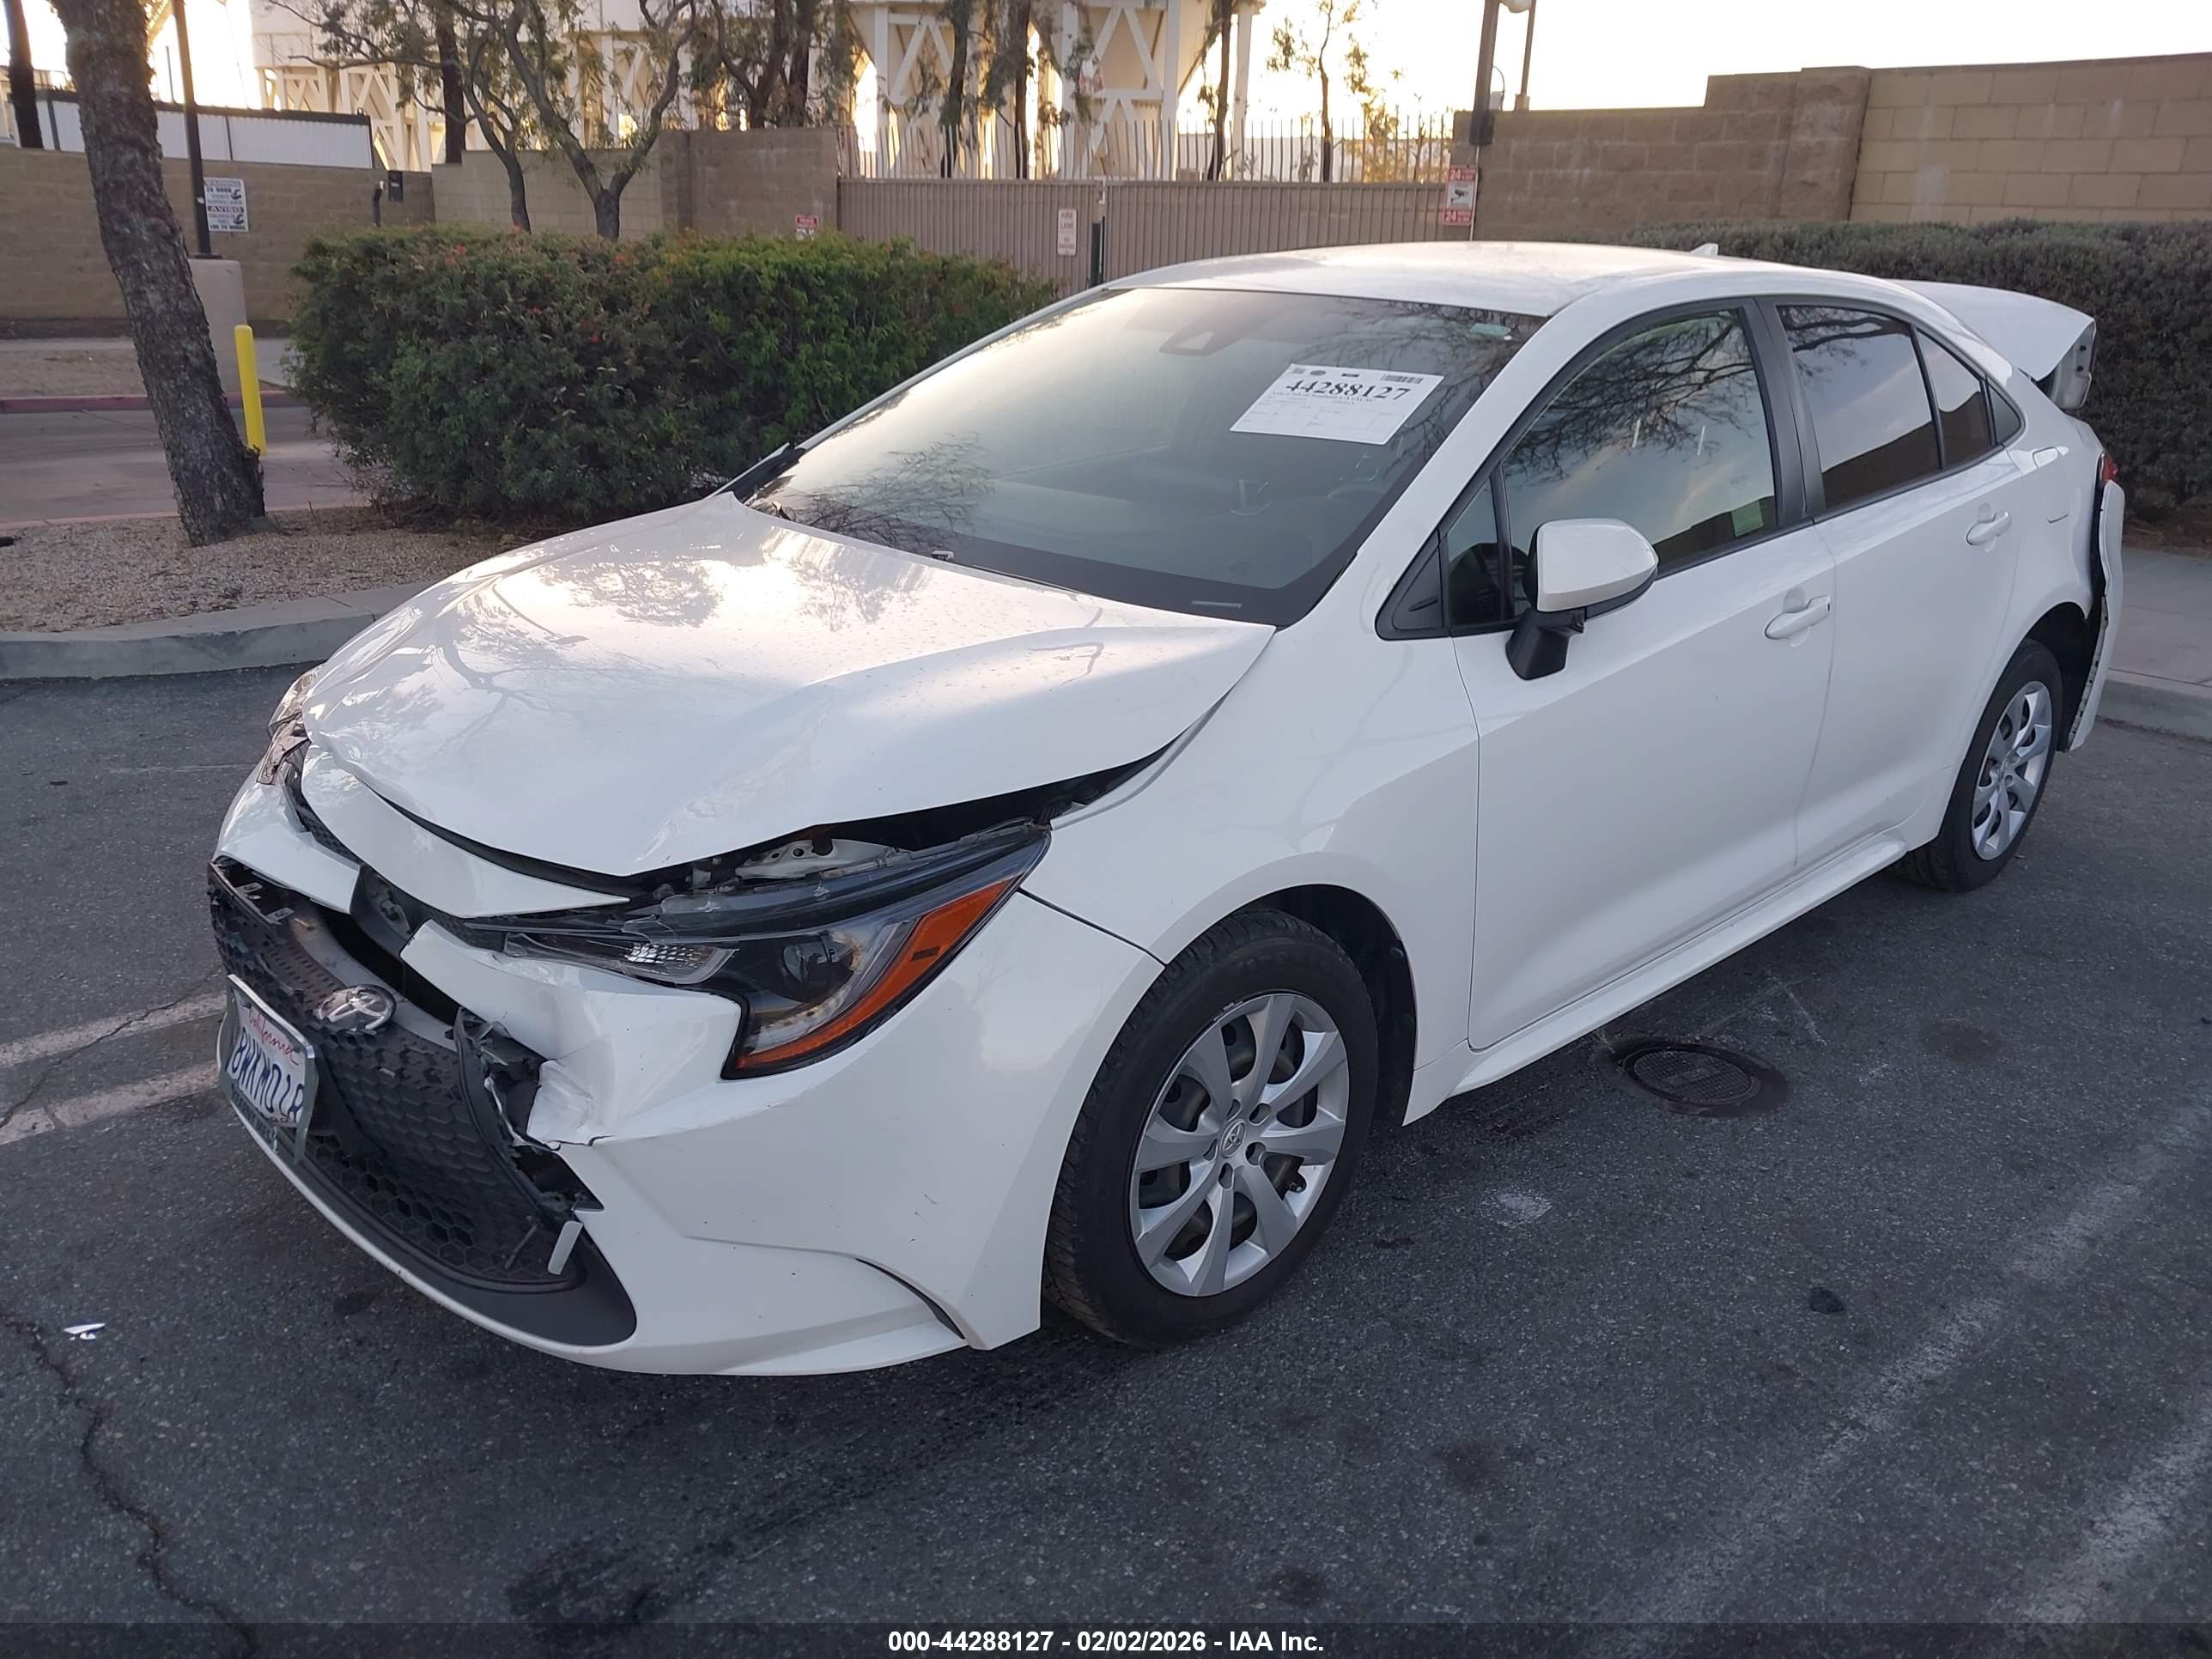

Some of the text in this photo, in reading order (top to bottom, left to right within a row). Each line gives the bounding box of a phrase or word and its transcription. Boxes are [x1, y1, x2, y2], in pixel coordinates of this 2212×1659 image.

[1450, 169, 1462, 179] 24
[1445, 211, 1457, 222] 24
[1285, 379, 1412, 400] 44288127
